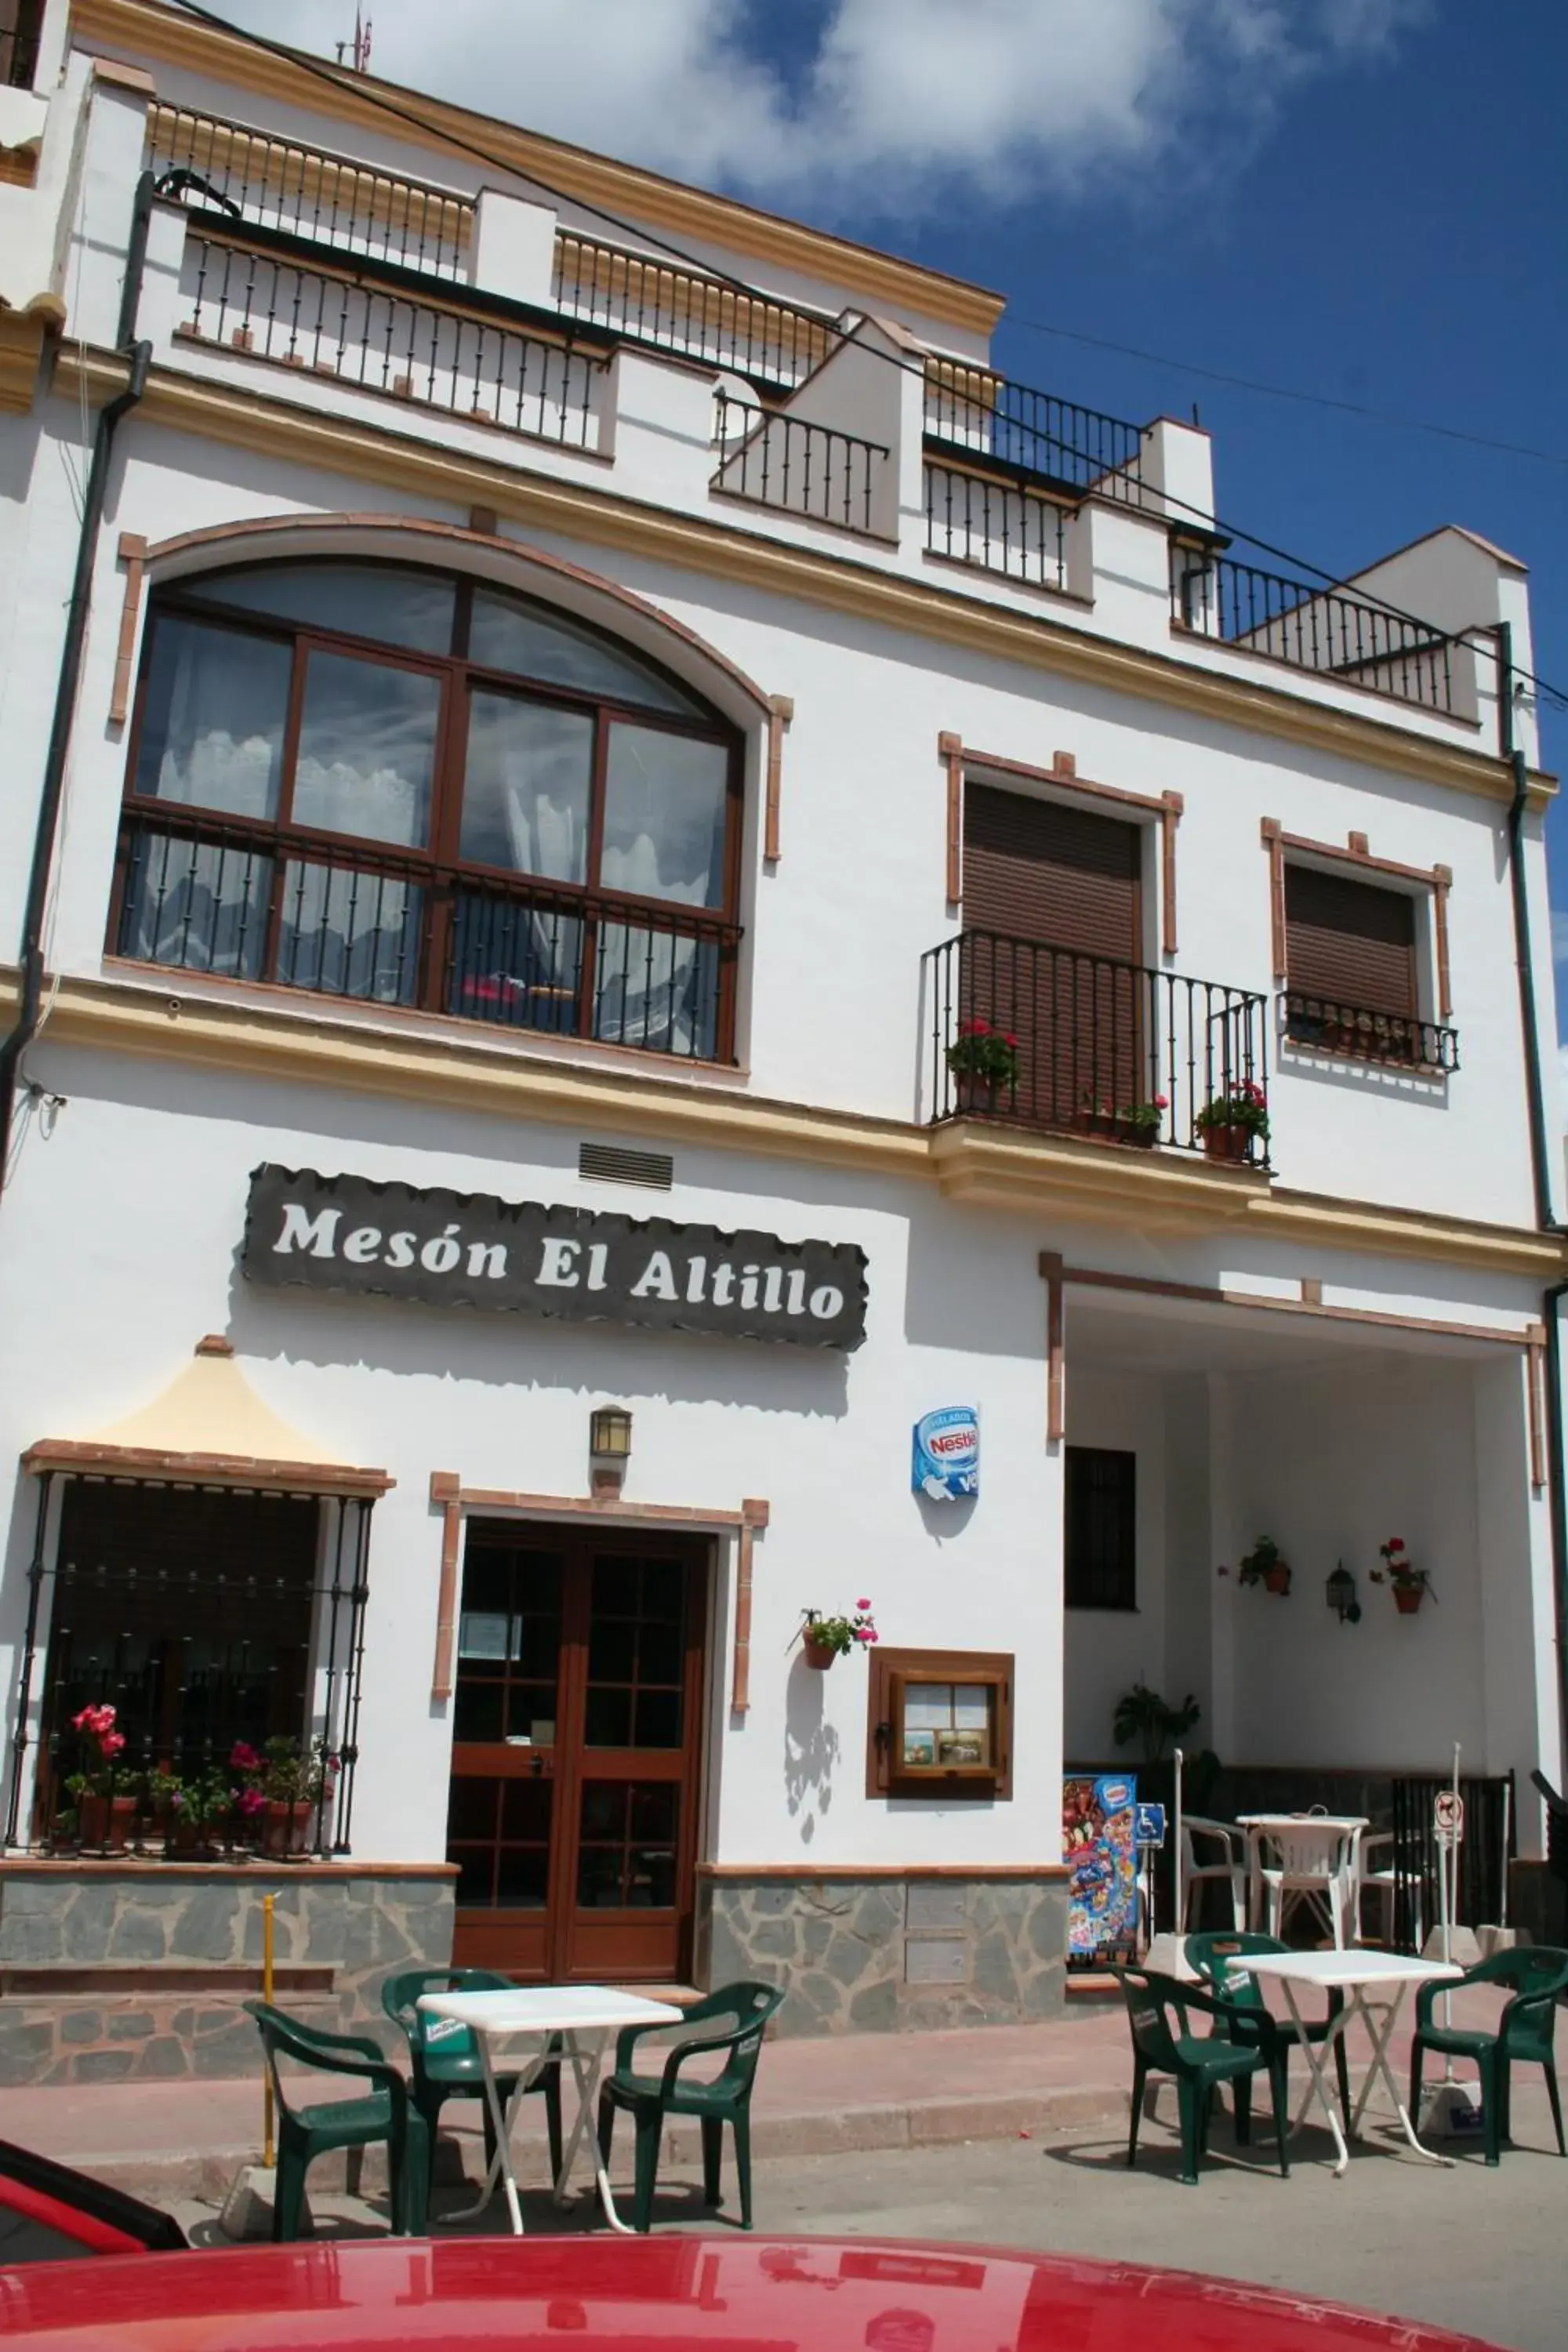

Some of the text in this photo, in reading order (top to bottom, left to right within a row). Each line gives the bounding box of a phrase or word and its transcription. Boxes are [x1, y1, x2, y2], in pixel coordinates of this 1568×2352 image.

[273, 1203, 844, 1319] Mesón El Altillo
